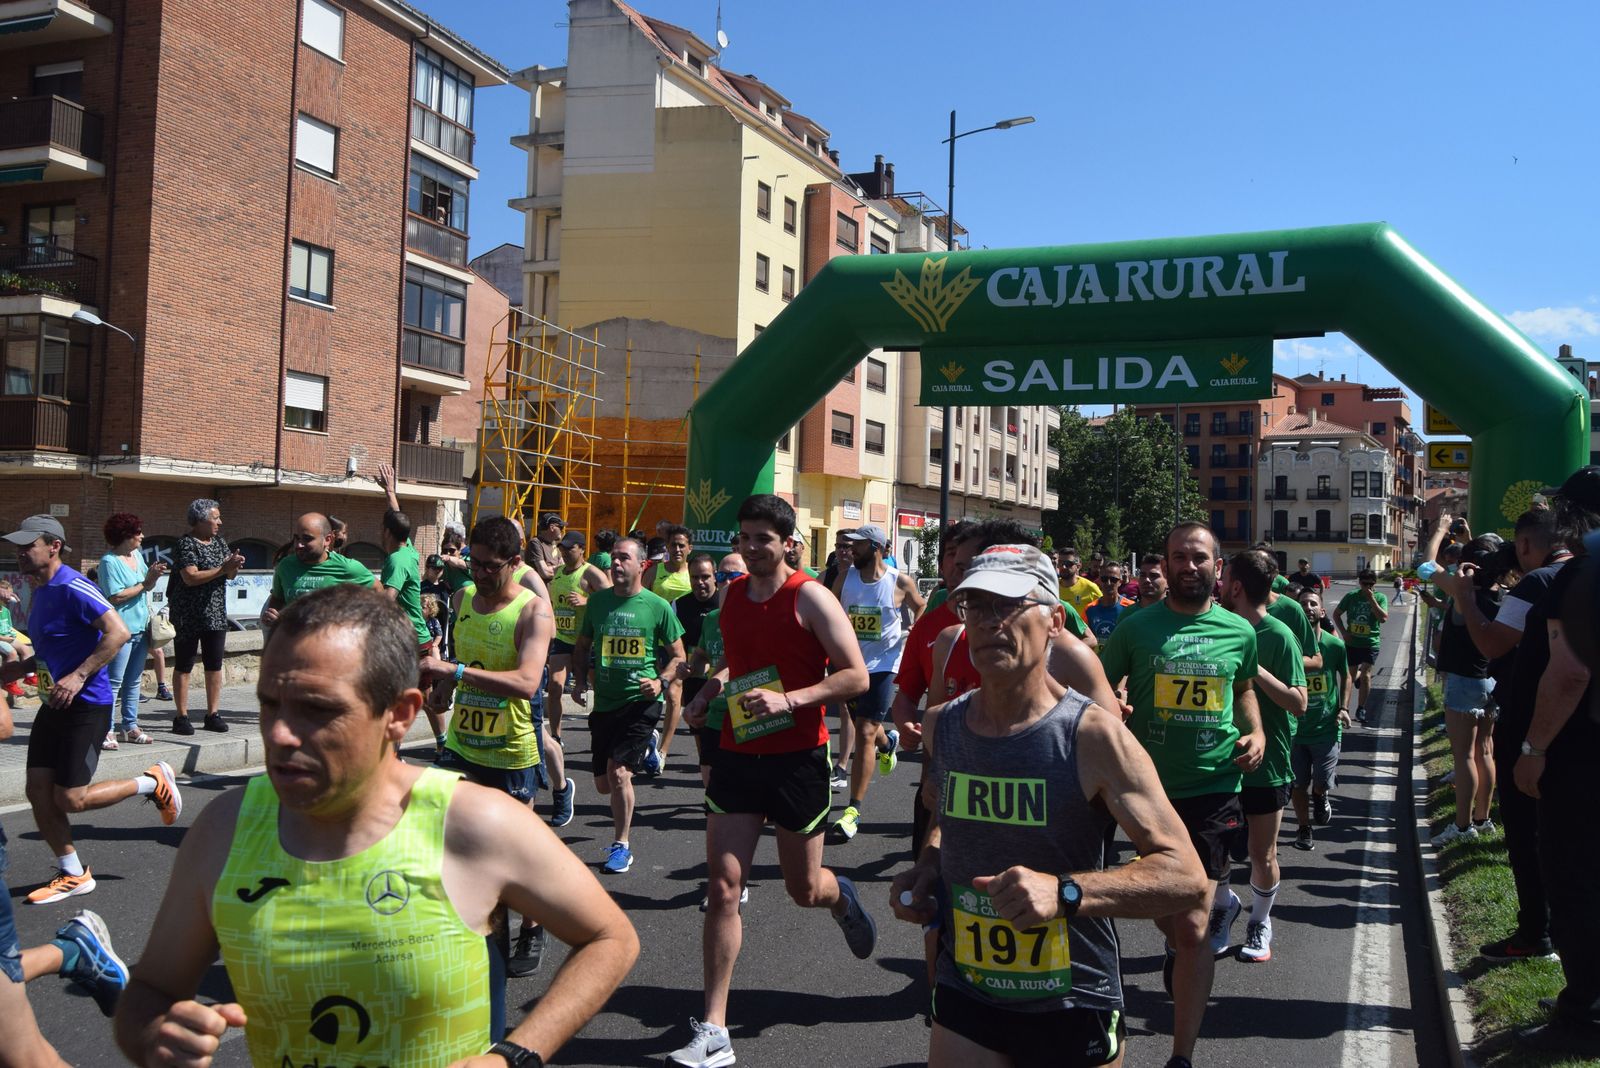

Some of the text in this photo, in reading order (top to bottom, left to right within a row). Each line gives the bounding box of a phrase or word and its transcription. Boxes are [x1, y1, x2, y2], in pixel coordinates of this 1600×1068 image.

[987, 250, 1306, 308] CAJA RURAL
[982, 355, 1199, 393] SALIDA
[1210, 376, 1258, 387] CAJA RURAL
[931, 383, 974, 392] CAJA RURAL
[608, 638, 640, 655] 108
[1172, 679, 1208, 707] 75
[459, 709, 499, 733] 207
[1174, 713, 1219, 723] CAJA RURAL
[947, 776, 957, 812] I
[968, 779, 1044, 821] RUN
[351, 934, 434, 951] Mercedes-Benz
[966, 921, 1049, 967] 197
[375, 952, 413, 964] Adarsa
[985, 977, 1016, 989] CAJA
